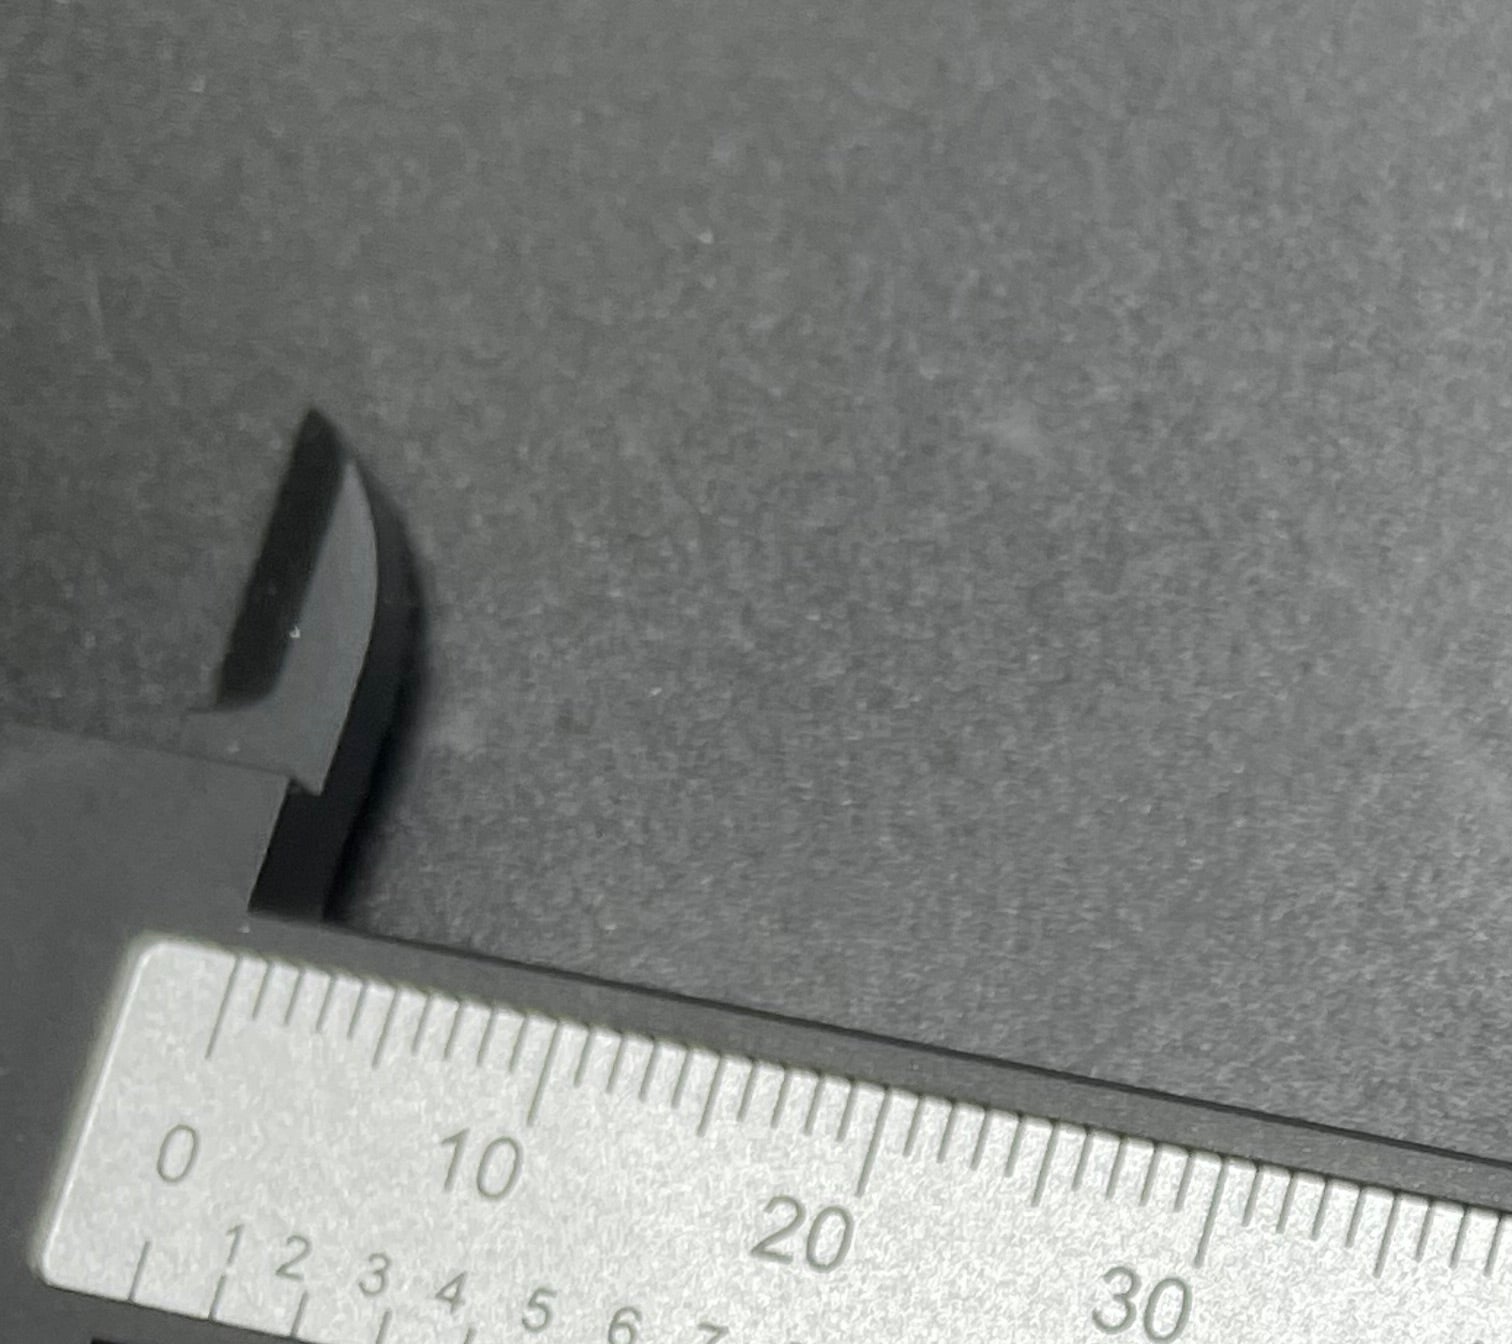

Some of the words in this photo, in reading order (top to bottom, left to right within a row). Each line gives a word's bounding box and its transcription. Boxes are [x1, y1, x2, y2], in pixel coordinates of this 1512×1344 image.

[156, 1125, 198, 1184] 0
[440, 1130, 524, 1199] 10
[751, 1198, 856, 1273] 20
[1092, 1265, 1193, 1344] 30
[224, 1225, 244, 1269] 1
[277, 1235, 312, 1281] 2
[359, 1253, 392, 1298] 3
[435, 1273, 468, 1315] 4
[522, 1287, 558, 1333] 5
